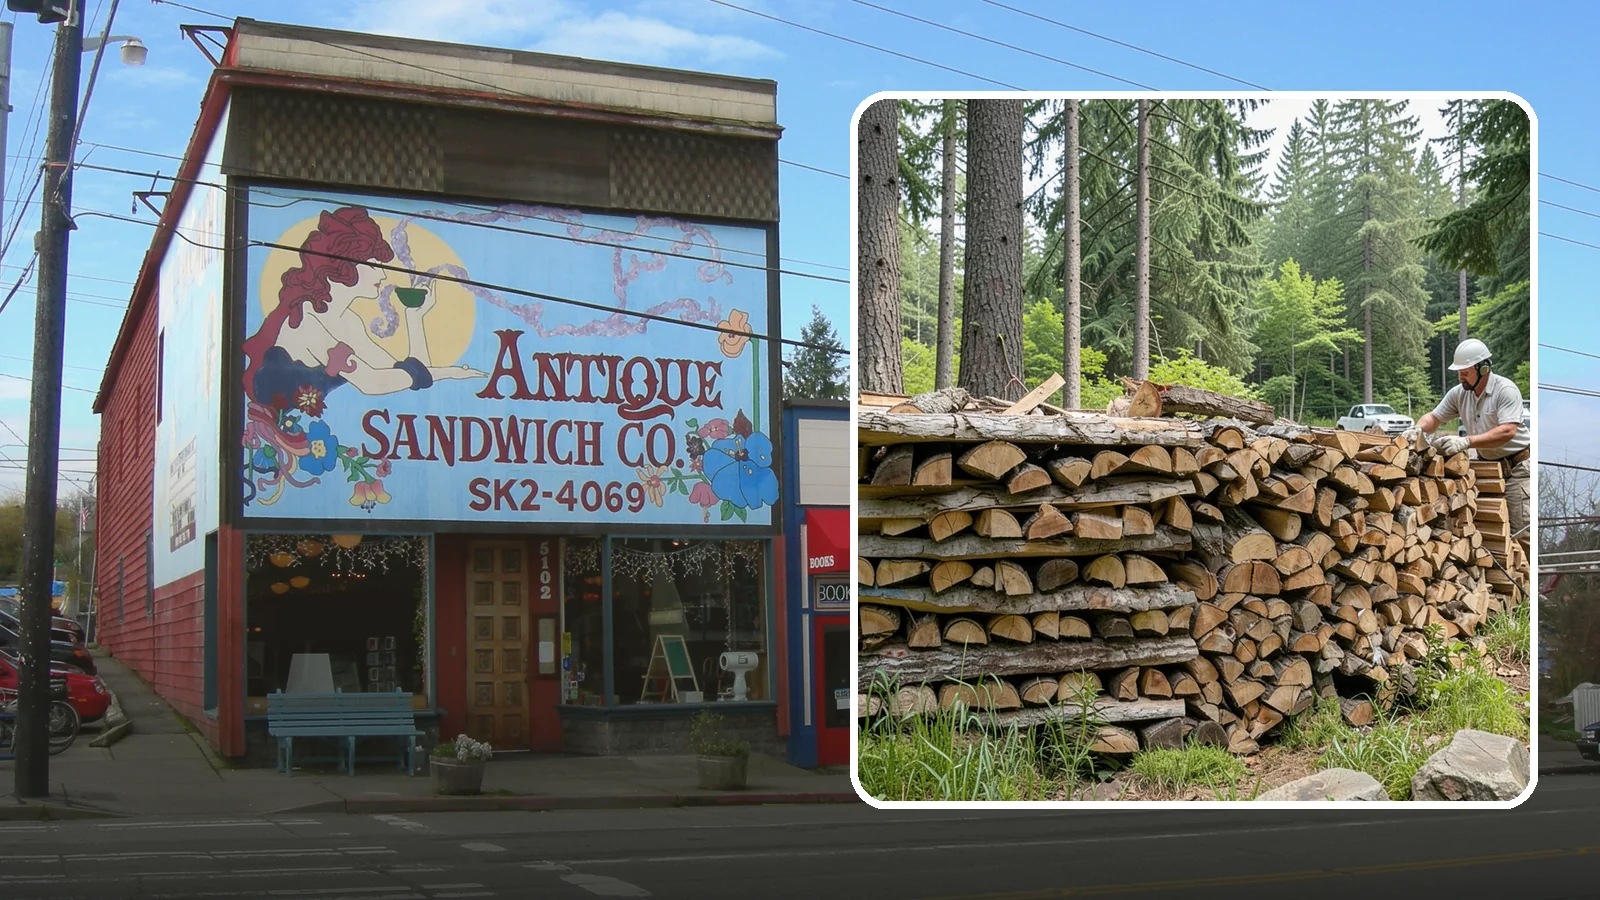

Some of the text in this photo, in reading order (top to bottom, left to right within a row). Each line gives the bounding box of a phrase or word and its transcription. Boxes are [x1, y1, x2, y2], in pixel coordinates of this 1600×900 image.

[476, 328, 723, 421] ANTIQUE
[361, 409, 685, 468] SANDWICH CO.
[468, 477, 646, 513] SK2-4069
[540, 541, 551, 600] 5102
[809, 555, 835, 569] BOOKS
